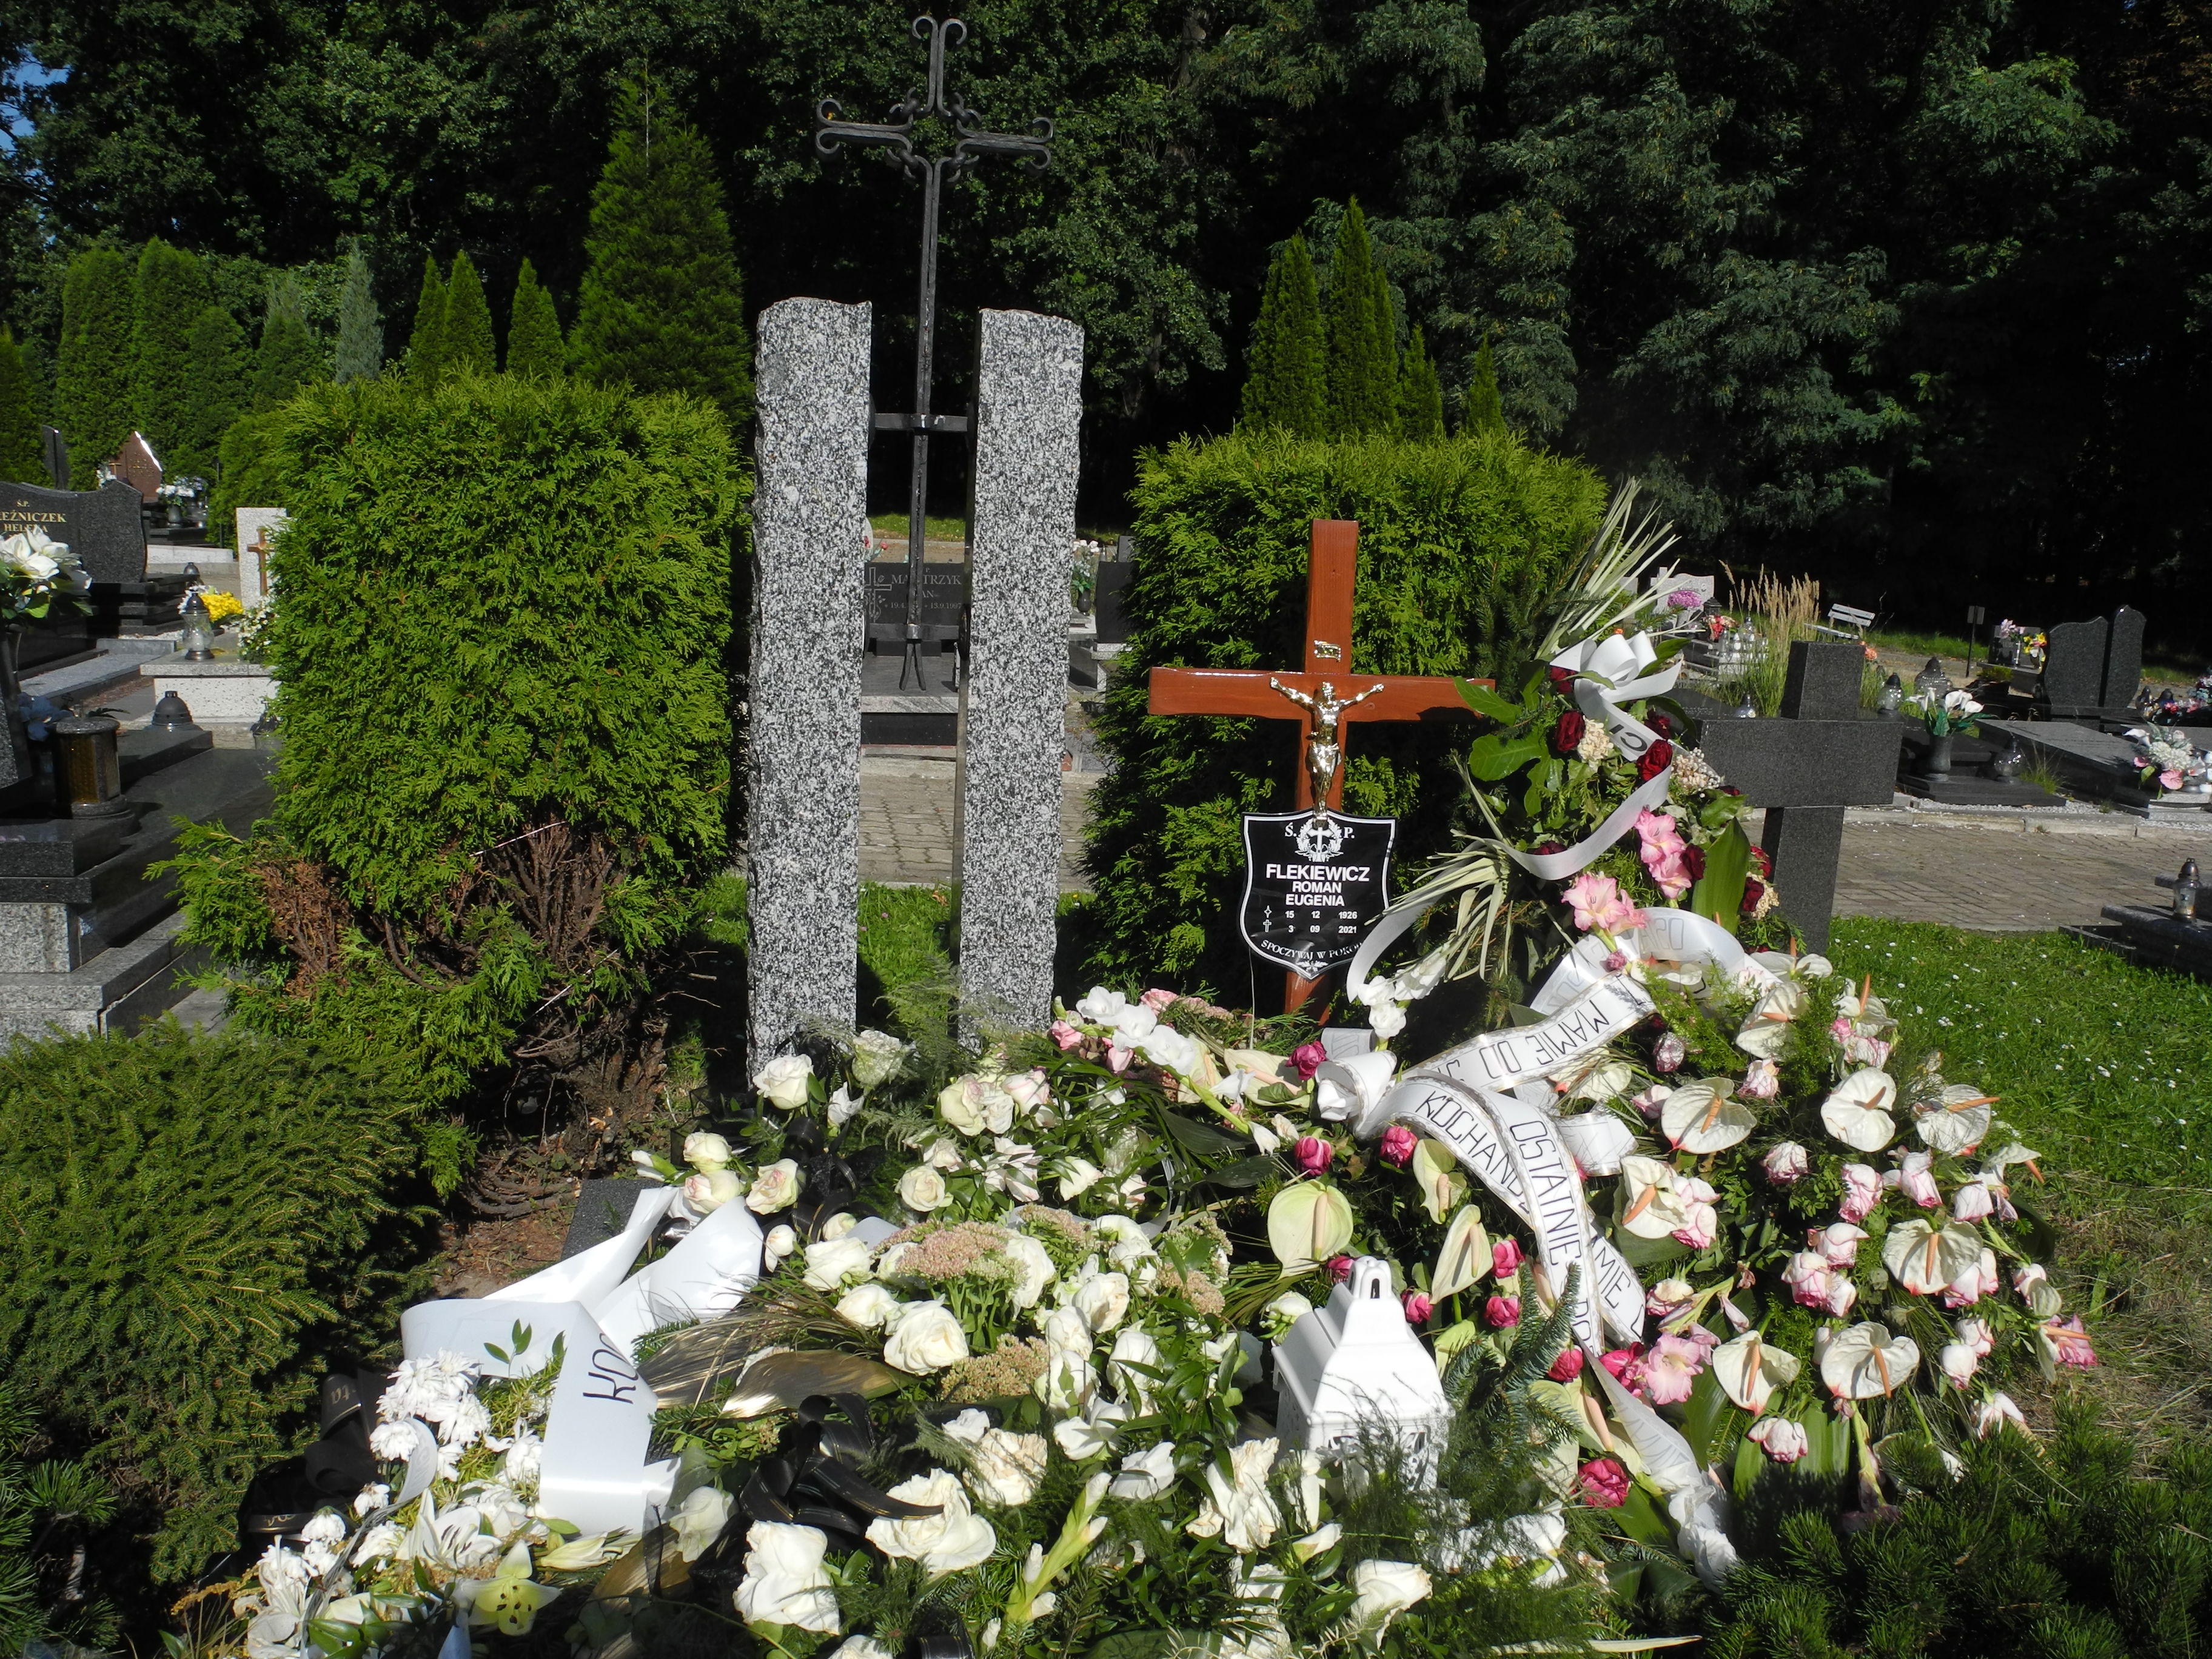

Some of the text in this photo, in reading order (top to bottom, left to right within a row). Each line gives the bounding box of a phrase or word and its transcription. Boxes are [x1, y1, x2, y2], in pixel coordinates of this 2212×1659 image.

[4, 523, 48, 532] HELEA
[891, 574, 962, 585] MATRZYK
[1265, 863, 1370, 882] FLEKIEWICZ
[1292, 881, 1342, 893] ROMAN
[1285, 894, 1345, 907] EUGENIA
[1338, 911, 1358, 920] 1926
[1310, 925, 1321, 933] 09
[1338, 925, 1358, 934] 2021
[1261, 939, 1313, 960] SPOCZYWAJ
[1316, 951, 1327, 959] W
[1524, 999, 1610, 1066] MAMIE
[1509, 1120, 1583, 1267] OSTATNIE
